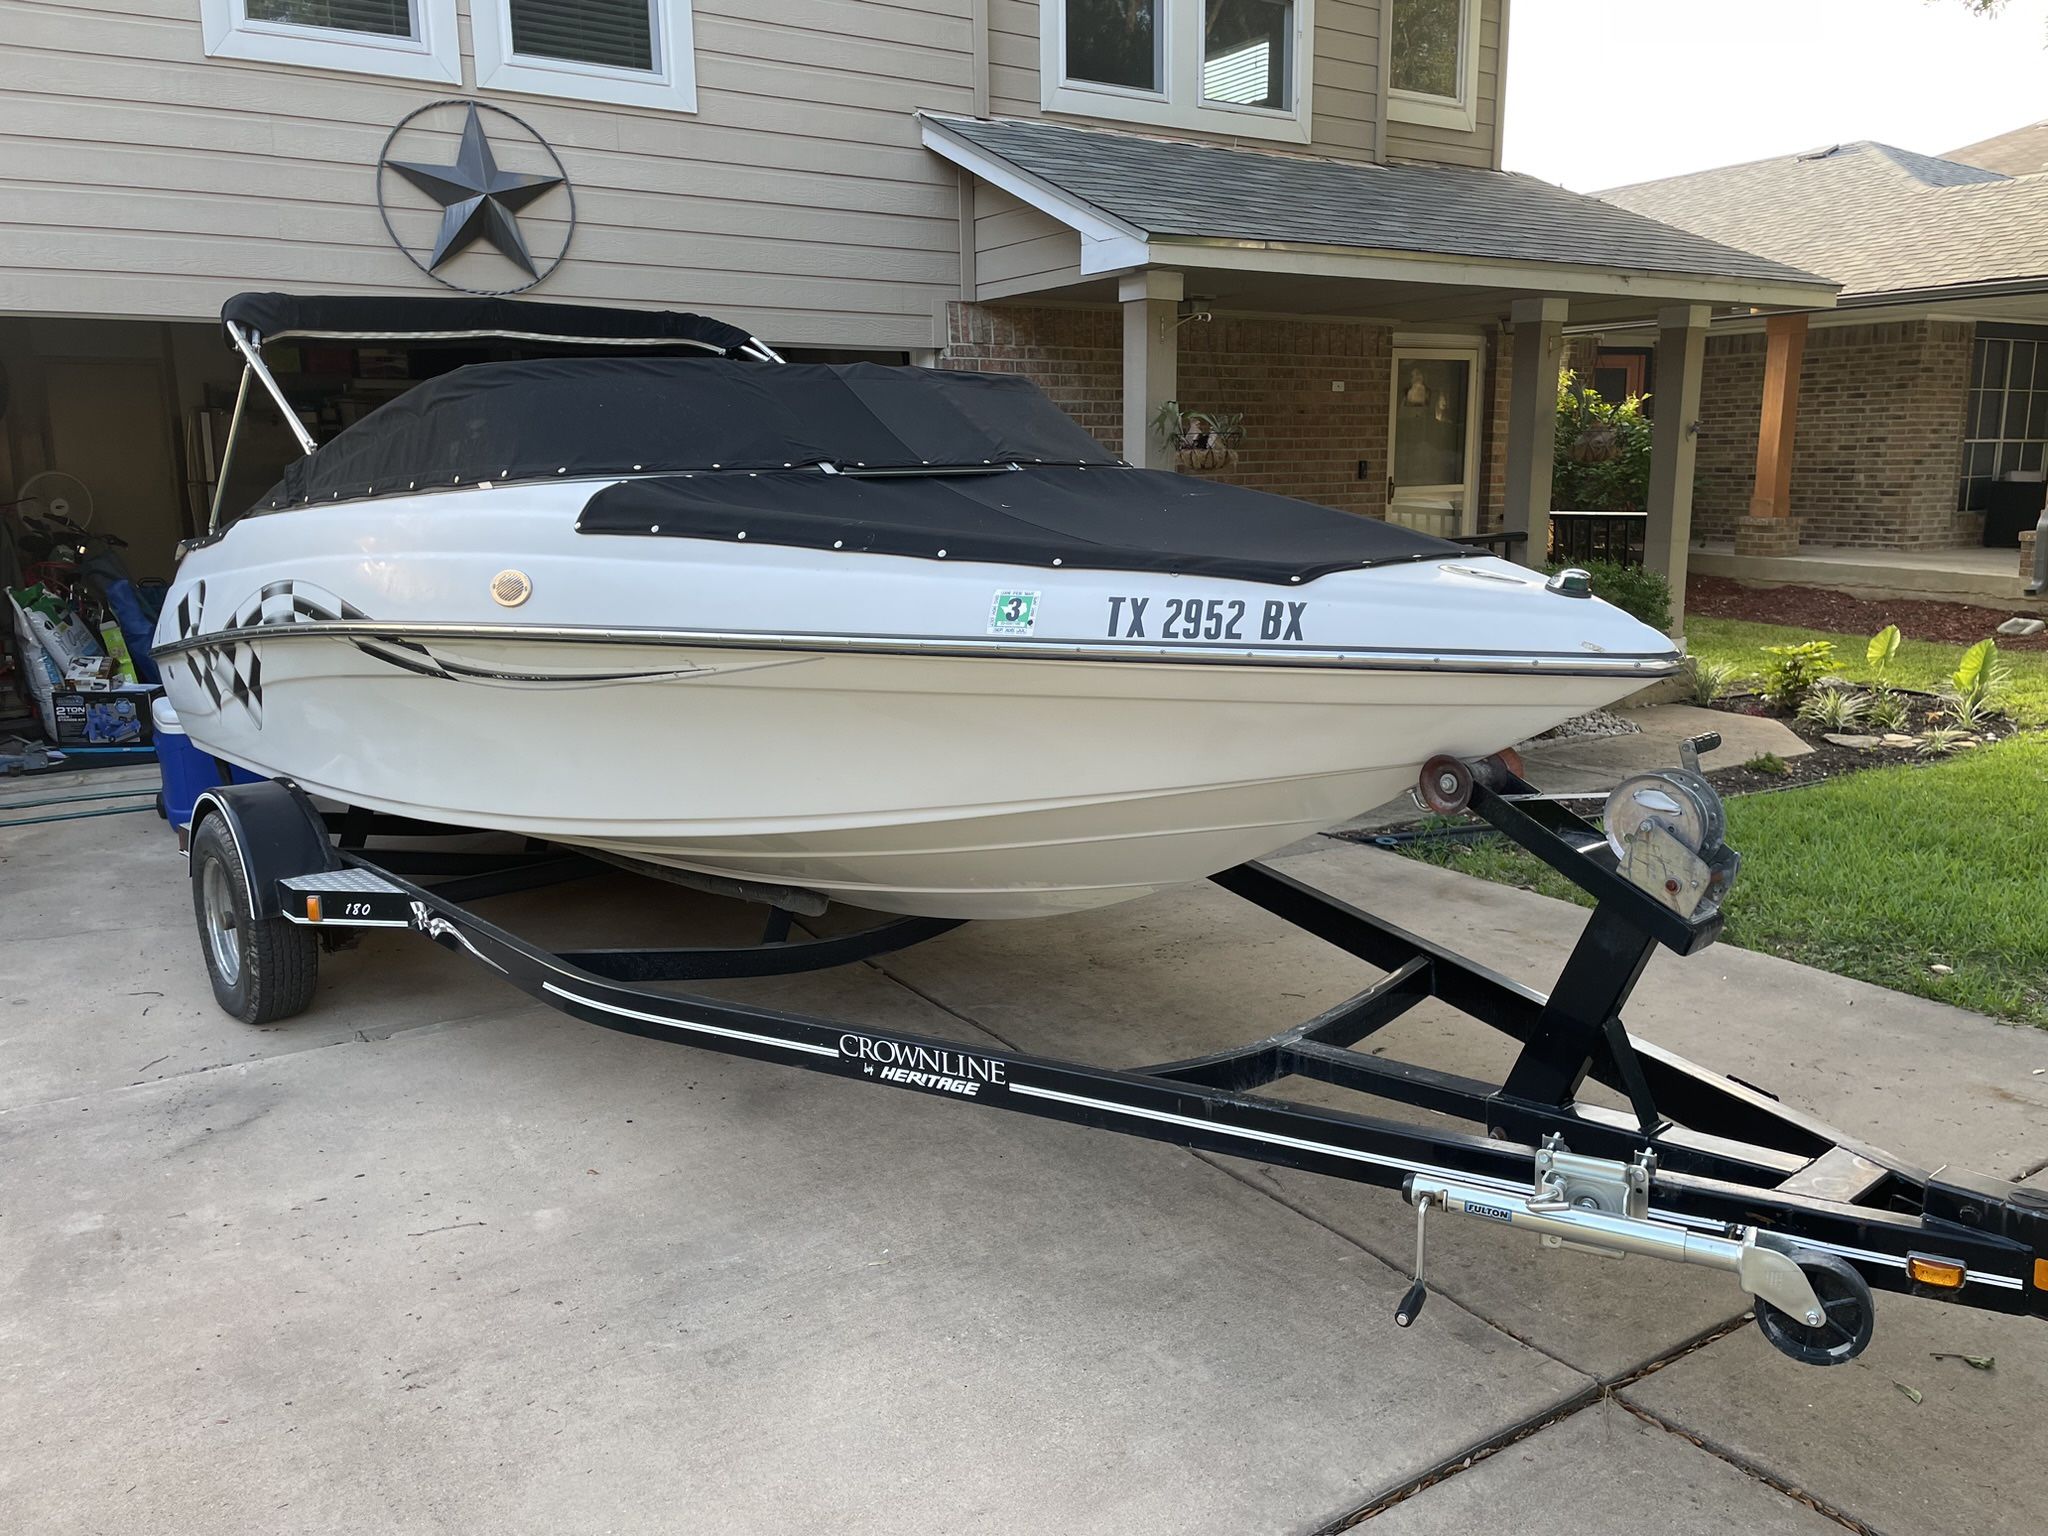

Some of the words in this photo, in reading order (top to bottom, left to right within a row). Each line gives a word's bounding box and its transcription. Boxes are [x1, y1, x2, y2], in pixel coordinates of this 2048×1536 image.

[1005, 597, 1022, 621] 3
[1107, 596, 1150, 638] TX
[1162, 599, 1246, 640] 2952
[1260, 600, 1308, 641] BX
[56, 706, 66, 716] 2
[345, 903, 371, 916] 180
[839, 1034, 1006, 1085] CROWNLINE
[863, 1062, 875, 1076] by
[880, 1066, 981, 1096] HERITAGE
[1468, 1204, 1508, 1218] FULTON
